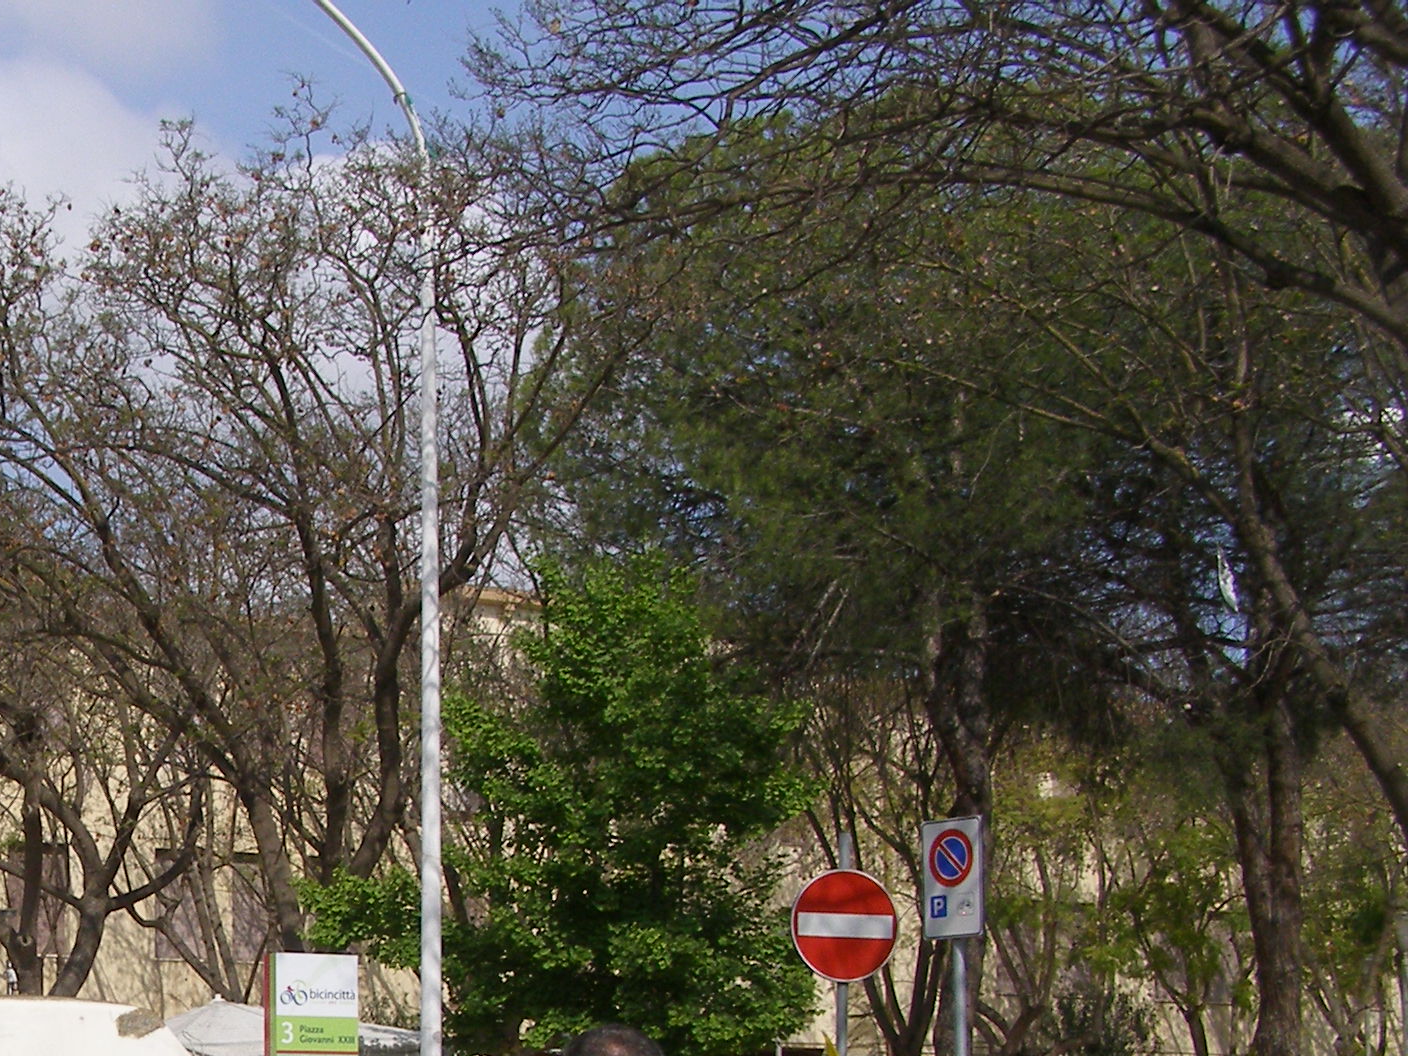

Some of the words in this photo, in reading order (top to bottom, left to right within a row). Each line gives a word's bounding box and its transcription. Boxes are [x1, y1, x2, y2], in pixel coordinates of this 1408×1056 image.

[309, 988, 356, 1000] bicincittà
[281, 1021, 293, 1044] 3
[299, 1024, 324, 1034] Piazza
[299, 1034, 334, 1043] Giovanni
[338, 1036, 355, 1044] XXIII
